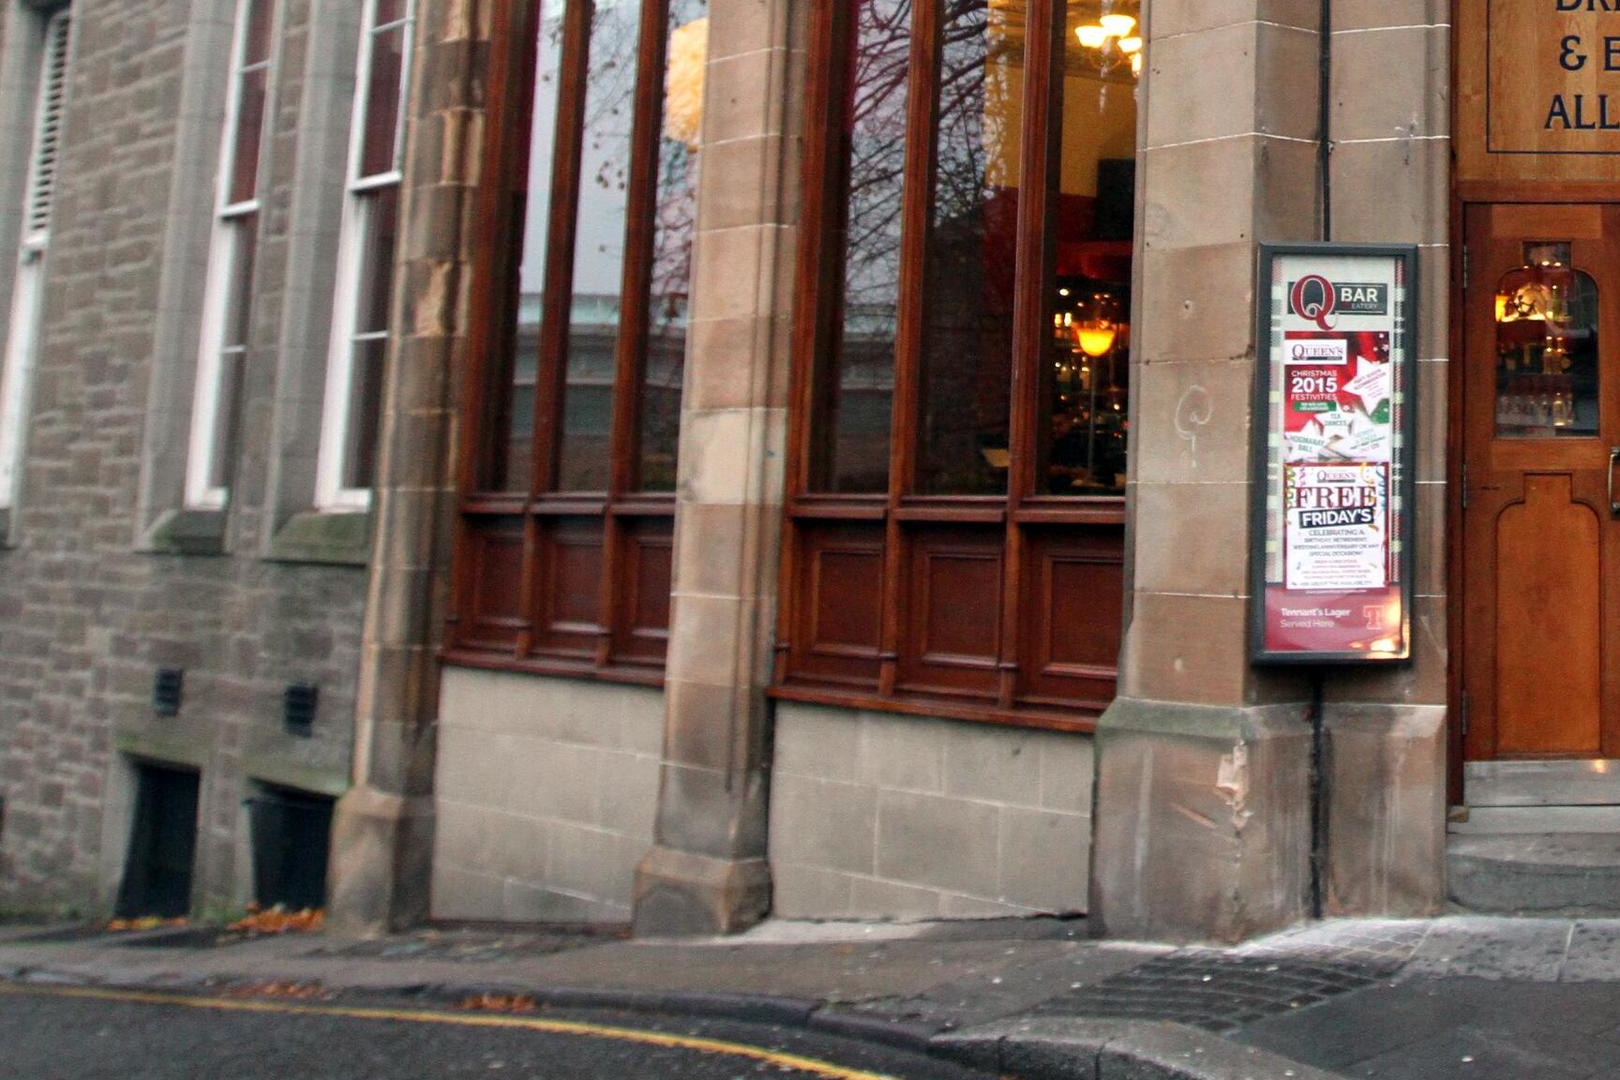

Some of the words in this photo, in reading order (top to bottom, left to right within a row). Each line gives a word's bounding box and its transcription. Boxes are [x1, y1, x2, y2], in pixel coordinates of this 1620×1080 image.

[1559, 35, 1588, 72] &
[1544, 94, 1620, 130] ALL
[1290, 275, 1339, 331] Q
[1340, 288, 1378, 302] BAR
[1292, 344, 1344, 360] QUEEN'S
[1292, 378, 1337, 393] 2015
[1291, 393, 1337, 401] FESTIVITIES
[1295, 486, 1377, 509] FREE
[1302, 508, 1372, 527] FRIDAY'S
[1280, 608, 1323, 617] Tennant's
[1324, 608, 1352, 618] Lager
[1280, 619, 1312, 628] Served
[1312, 619, 1335, 628] Here
